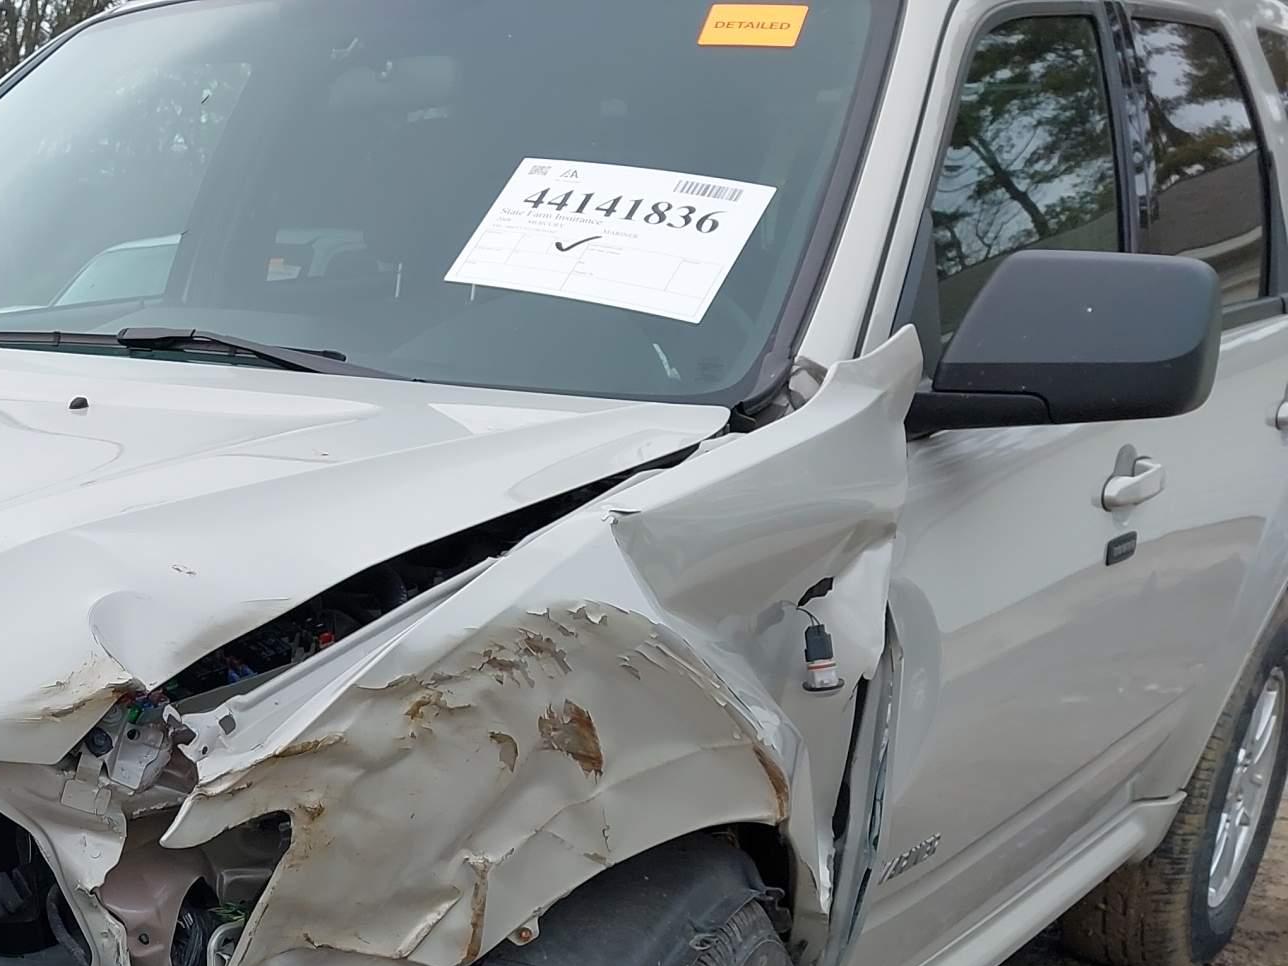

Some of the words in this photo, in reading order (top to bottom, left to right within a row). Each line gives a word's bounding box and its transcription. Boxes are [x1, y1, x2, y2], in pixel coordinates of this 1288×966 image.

[713, 21, 791, 30] DETAILED
[501, 207, 525, 217] State
[555, 213, 604, 226] Insurance
[523, 186, 728, 234] 44141836
